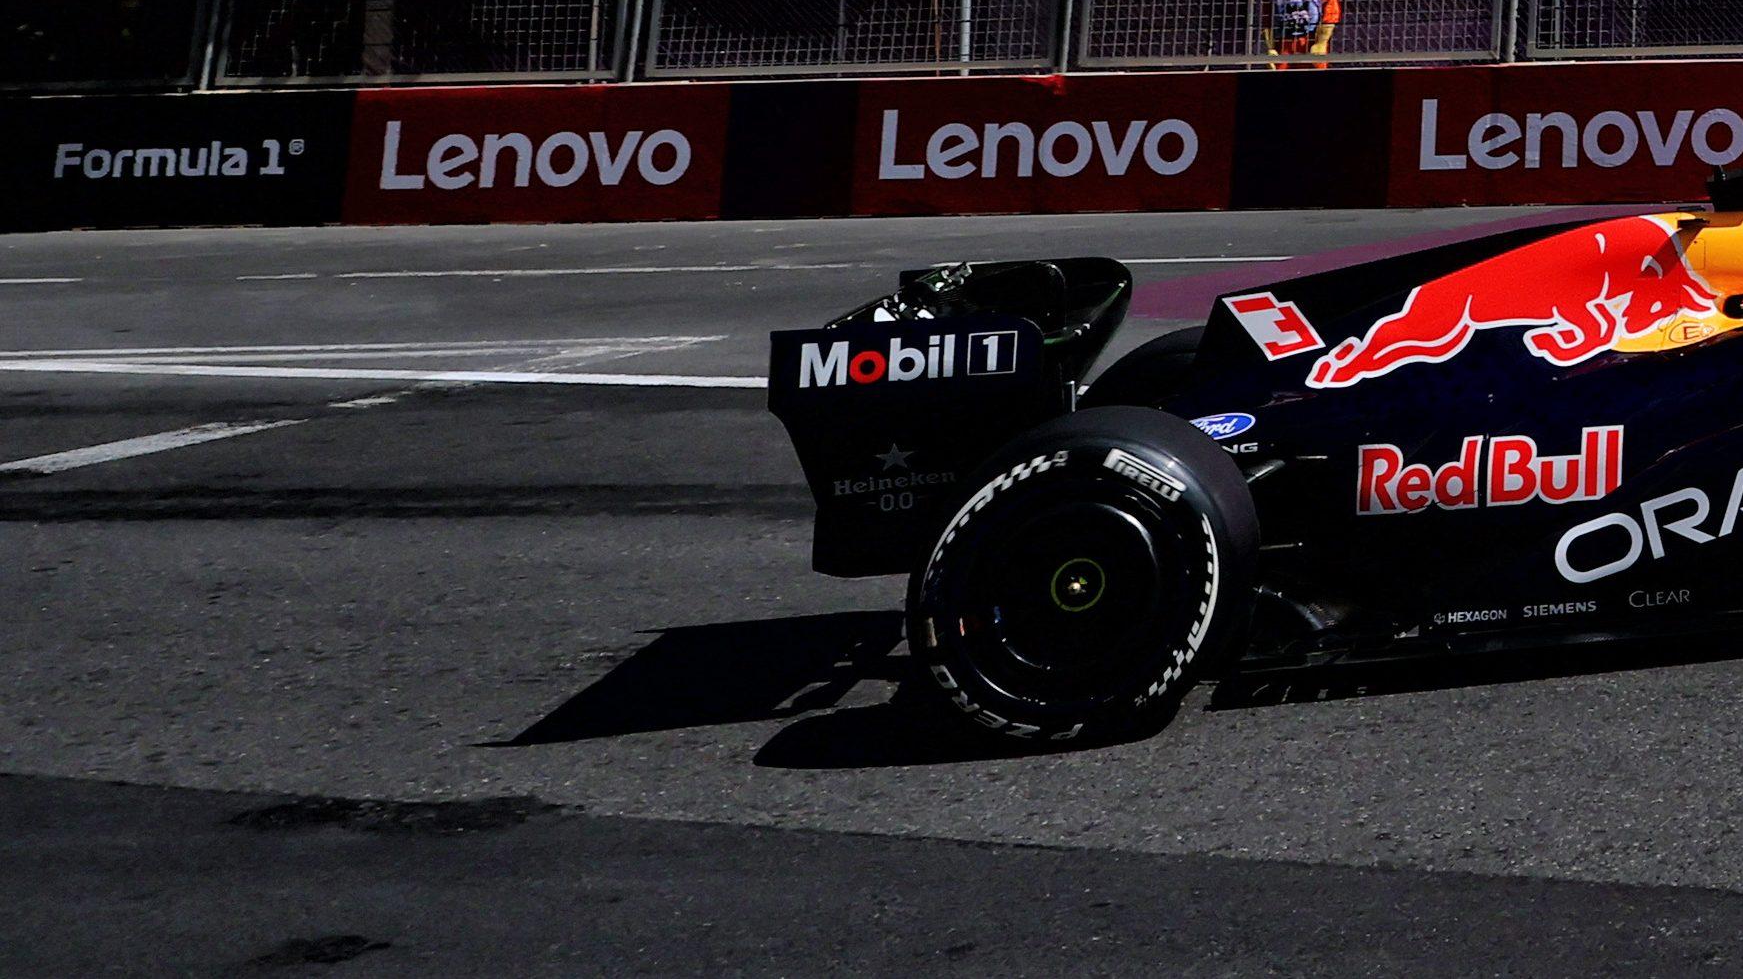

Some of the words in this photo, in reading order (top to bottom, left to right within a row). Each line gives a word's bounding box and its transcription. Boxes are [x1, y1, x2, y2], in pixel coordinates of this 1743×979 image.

[54, 140, 249, 179] Formula
[380, 120, 692, 190] Lenovo
[879, 109, 1199, 181] Lenovo
[1225, 293, 1324, 360] 3
[799, 334, 955, 388] Mobil
[833, 471, 956, 496] Heineken
[1103, 448, 1187, 502] PIRELLI
[1357, 434, 1483, 515] Red
[1486, 425, 1624, 505] Bull
[1448, 609, 1508, 623] HEXAGON
[1523, 601, 1597, 617] SIEMENS
[1628, 589, 1690, 608] CLEAR
